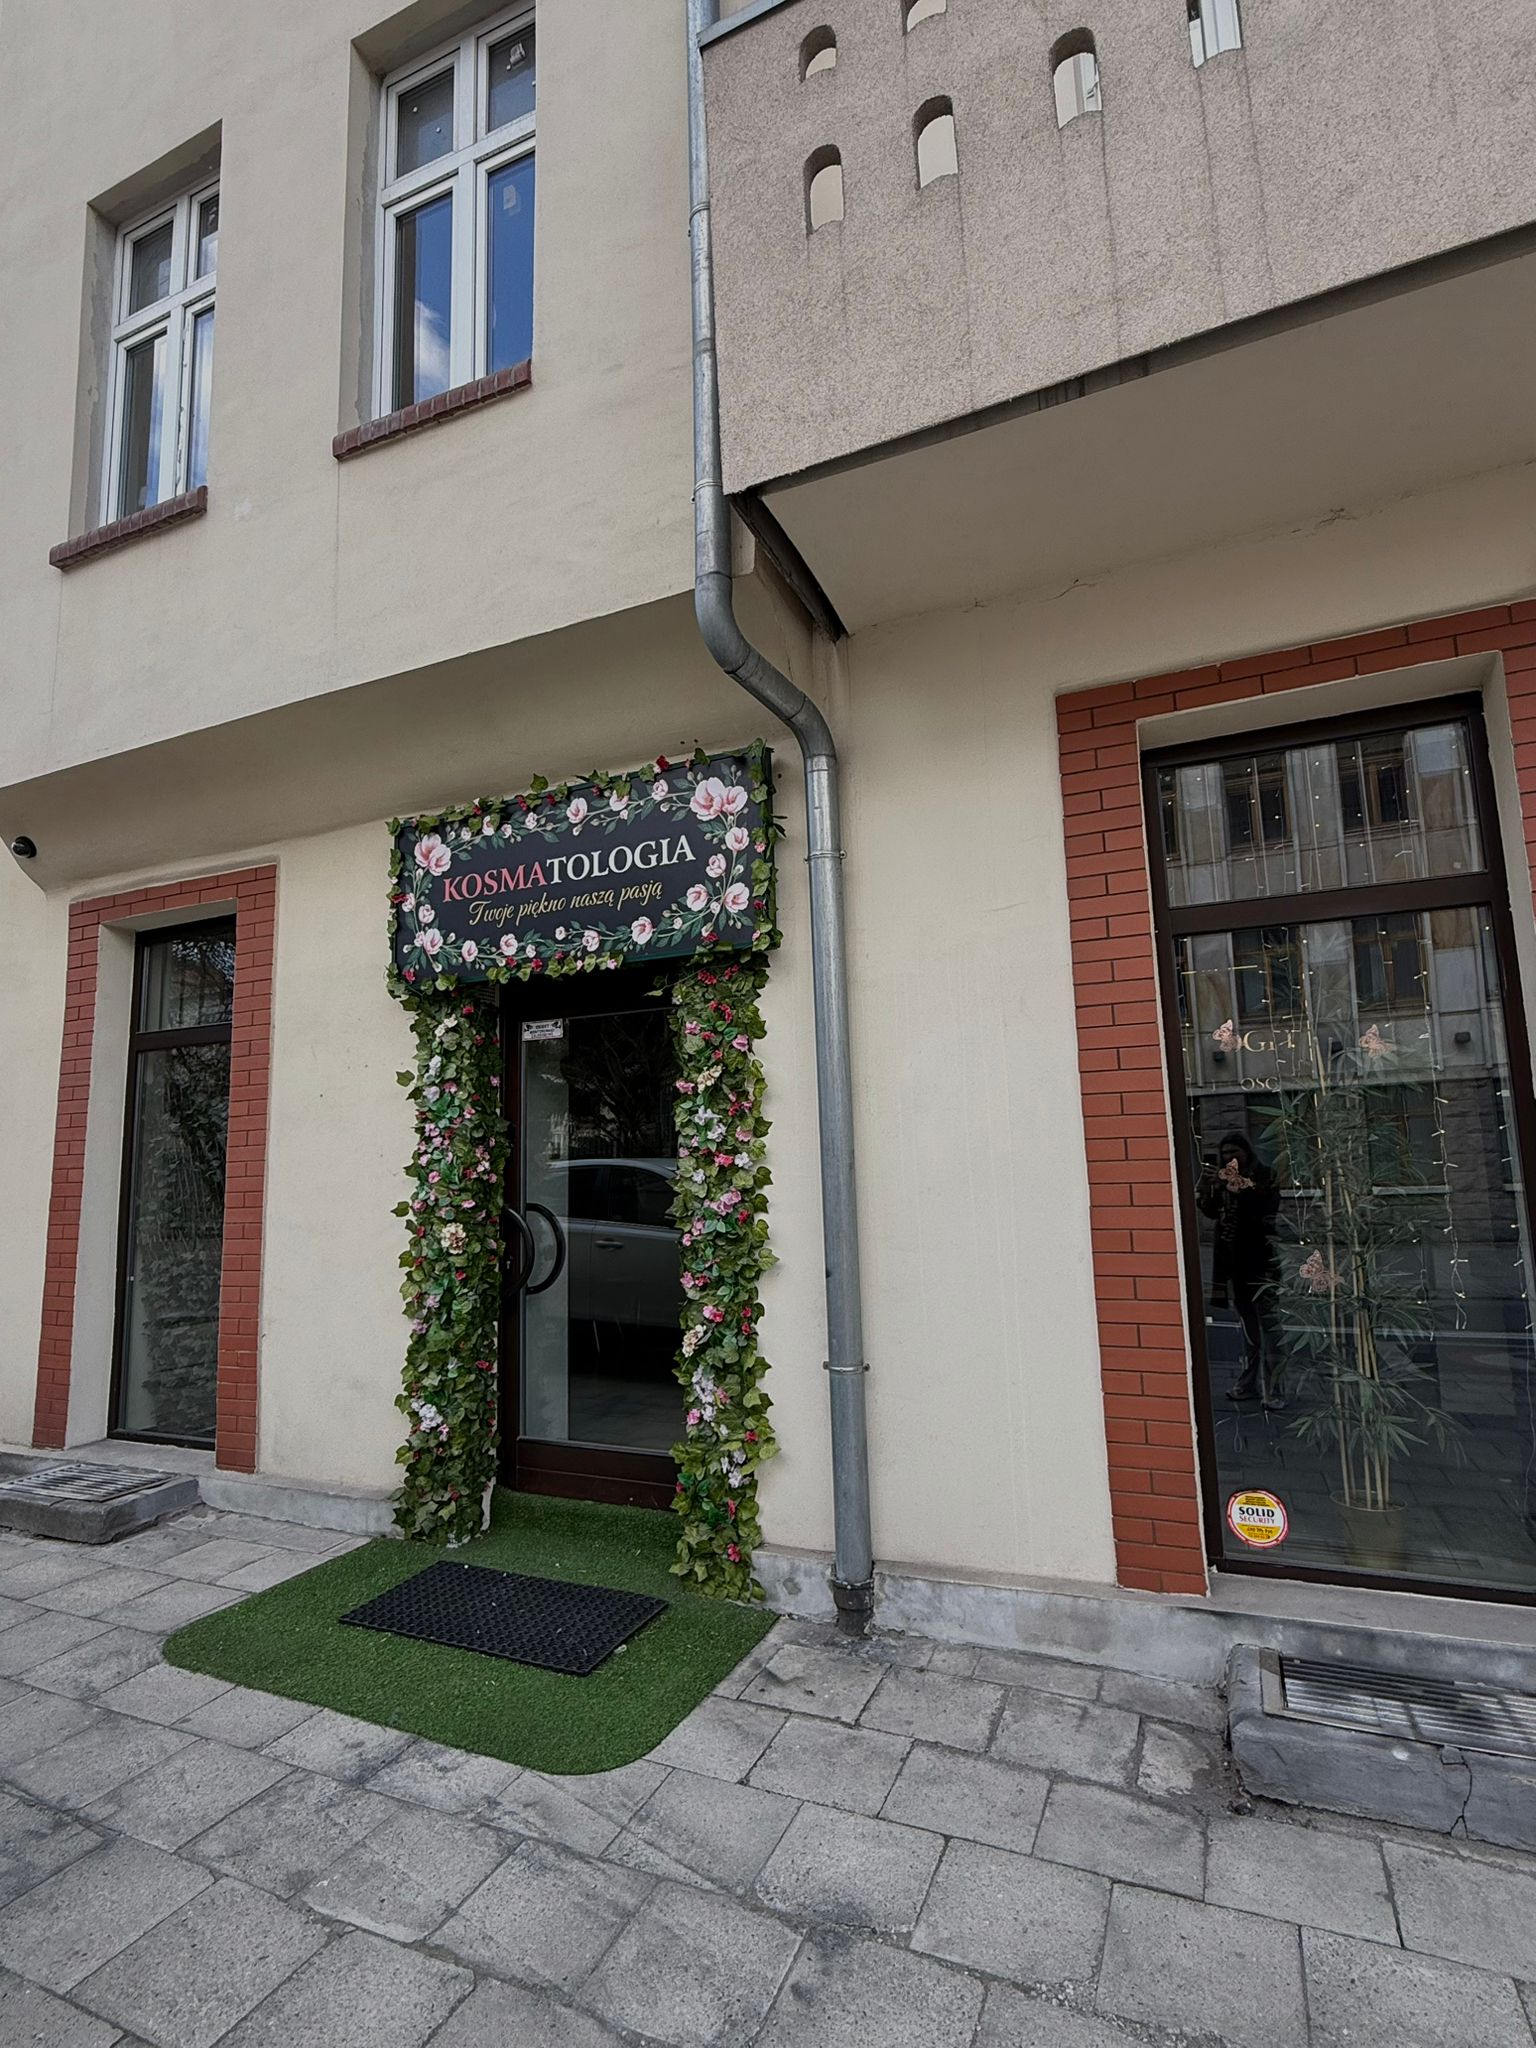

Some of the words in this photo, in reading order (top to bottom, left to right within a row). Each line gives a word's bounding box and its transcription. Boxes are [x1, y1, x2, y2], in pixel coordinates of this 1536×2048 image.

[442, 834, 697, 903] KOSMATOLOGIA
[468, 900, 515, 928] Twoje
[515, 892, 567, 926] piękno
[569, 889, 615, 909] naszą
[617, 880, 663, 911] pasją
[1238, 1506, 1275, 1518] SOLID
[1239, 1515, 1276, 1525] SECURITY
